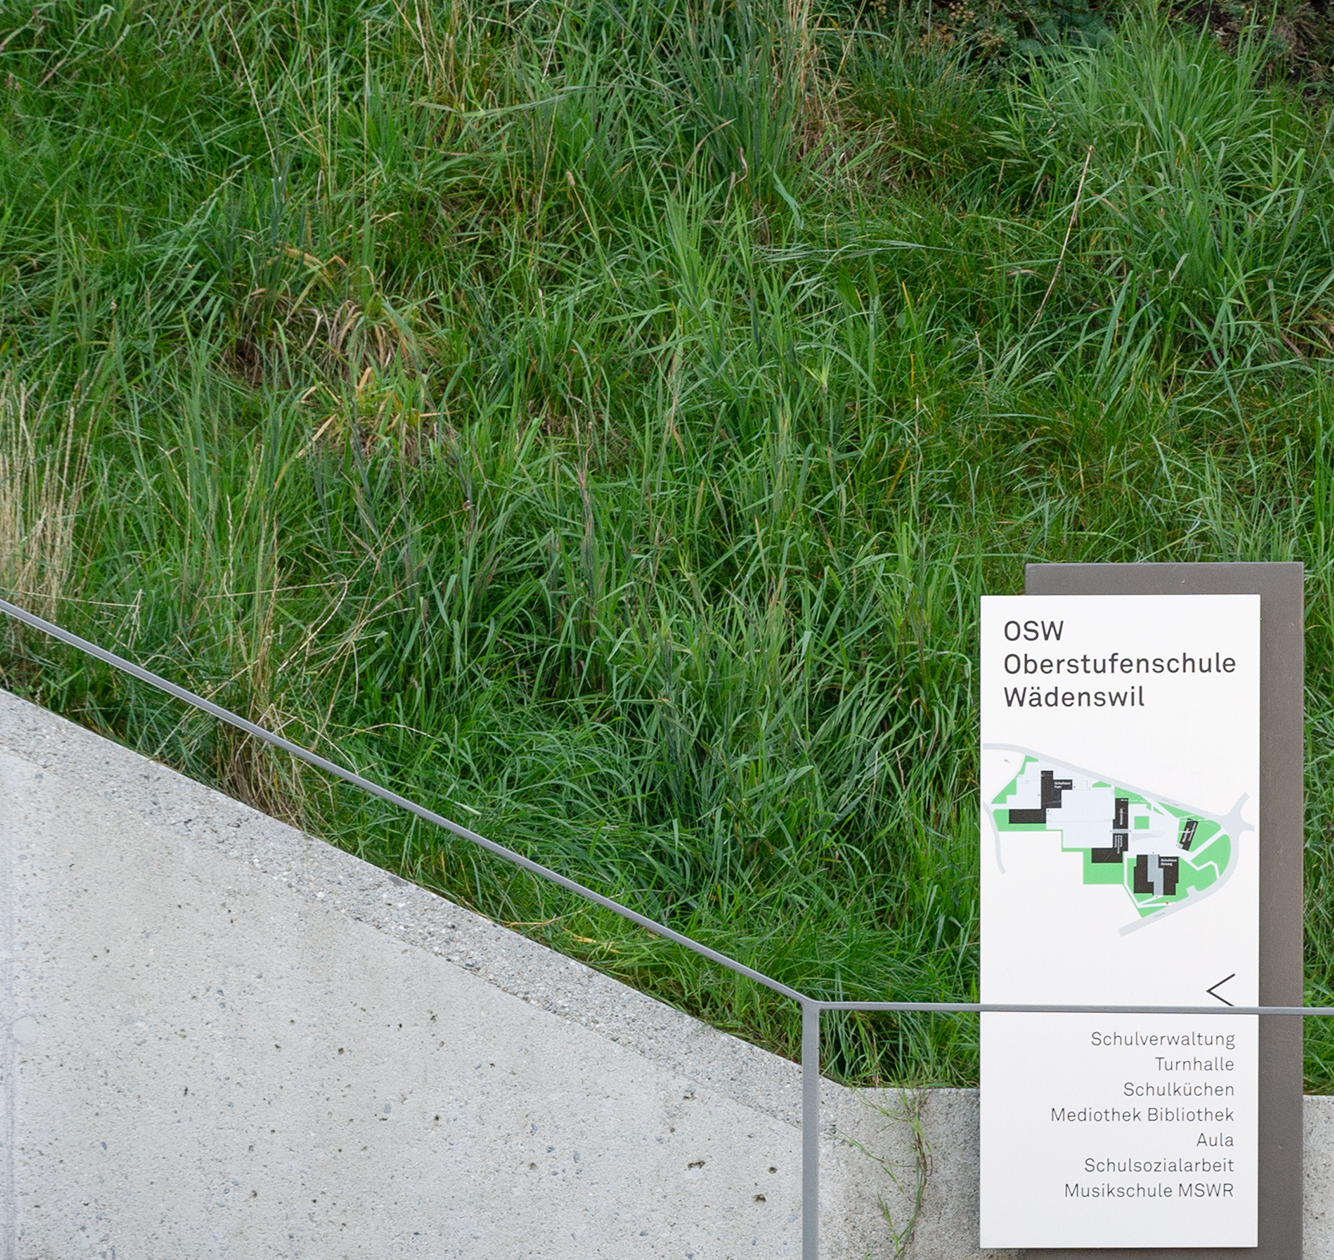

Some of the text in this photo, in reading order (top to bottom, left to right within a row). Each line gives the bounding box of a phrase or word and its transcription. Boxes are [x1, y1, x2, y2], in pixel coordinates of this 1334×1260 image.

[1003, 620, 1065, 642] OSW
[1003, 652, 1237, 675] Oberstufenschule
[1003, 685, 1146, 708] Wädenswil
[1090, 1031, 1236, 1050] Schulverwaltung
[1155, 1057, 1235, 1072] Turnhalle
[1123, 1082, 1235, 1097] Schulküchen
[1050, 1107, 1235, 1122] Mediothek Bibliothek
[1196, 1132, 1235, 1147] Aula
[1084, 1157, 1235, 1173] Schulsozialarbeit
[1064, 1182, 1234, 1198] Musikschule MSWR
